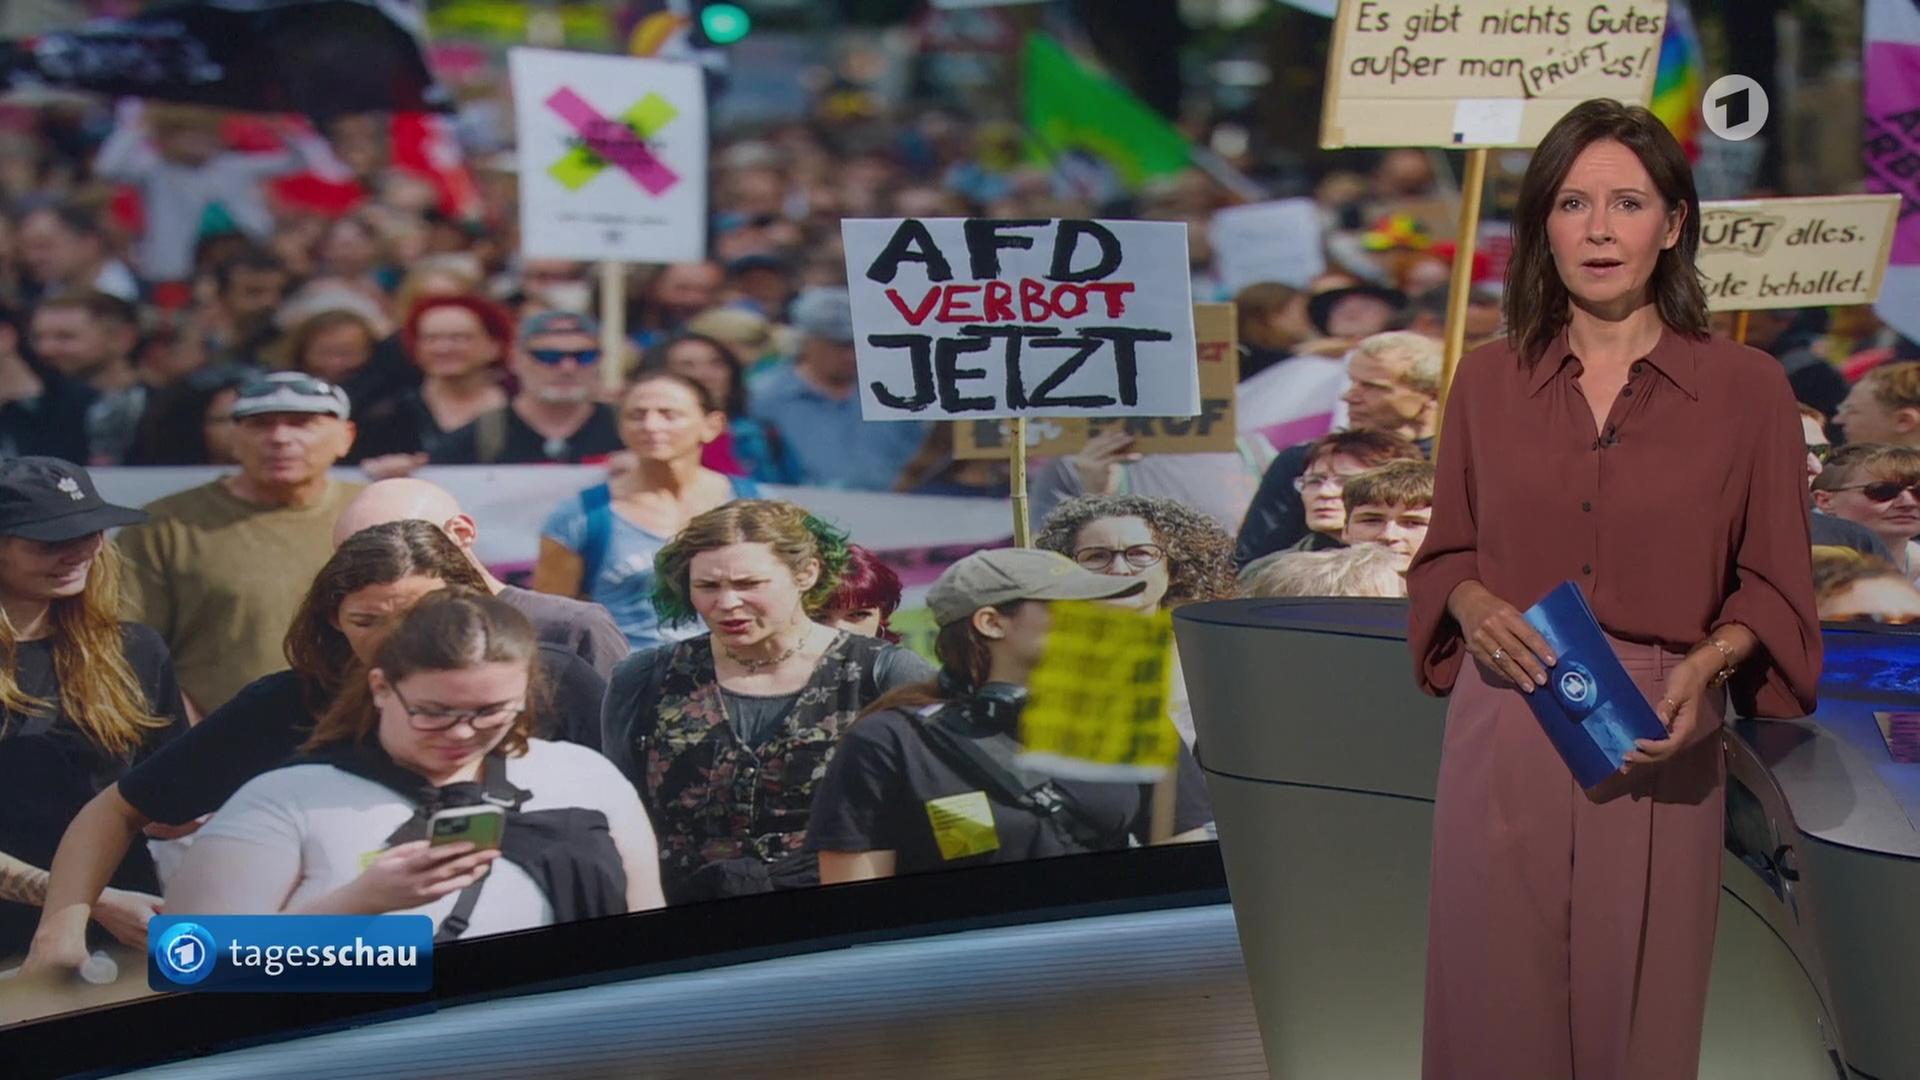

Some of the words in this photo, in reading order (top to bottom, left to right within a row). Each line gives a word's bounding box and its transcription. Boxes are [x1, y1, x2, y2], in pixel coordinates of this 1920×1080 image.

[1356, 2, 1390, 33] Es
[1404, 4, 1462, 41] gibt
[1480, 4, 1571, 36] nichts
[1587, 5, 1663, 35] Gutes
[1350, 46, 1445, 84] außer
[1459, 57, 1524, 77] man
[1529, 41, 1609, 91] PRÜFT
[866, 218, 1122, 284] AFD
[1701, 215, 1775, 248] ÜFT
[1786, 219, 1866, 246] alles.
[885, 277, 1135, 326] VERBOT
[1701, 273, 1748, 298] ute
[867, 324, 1172, 413] JETZT
